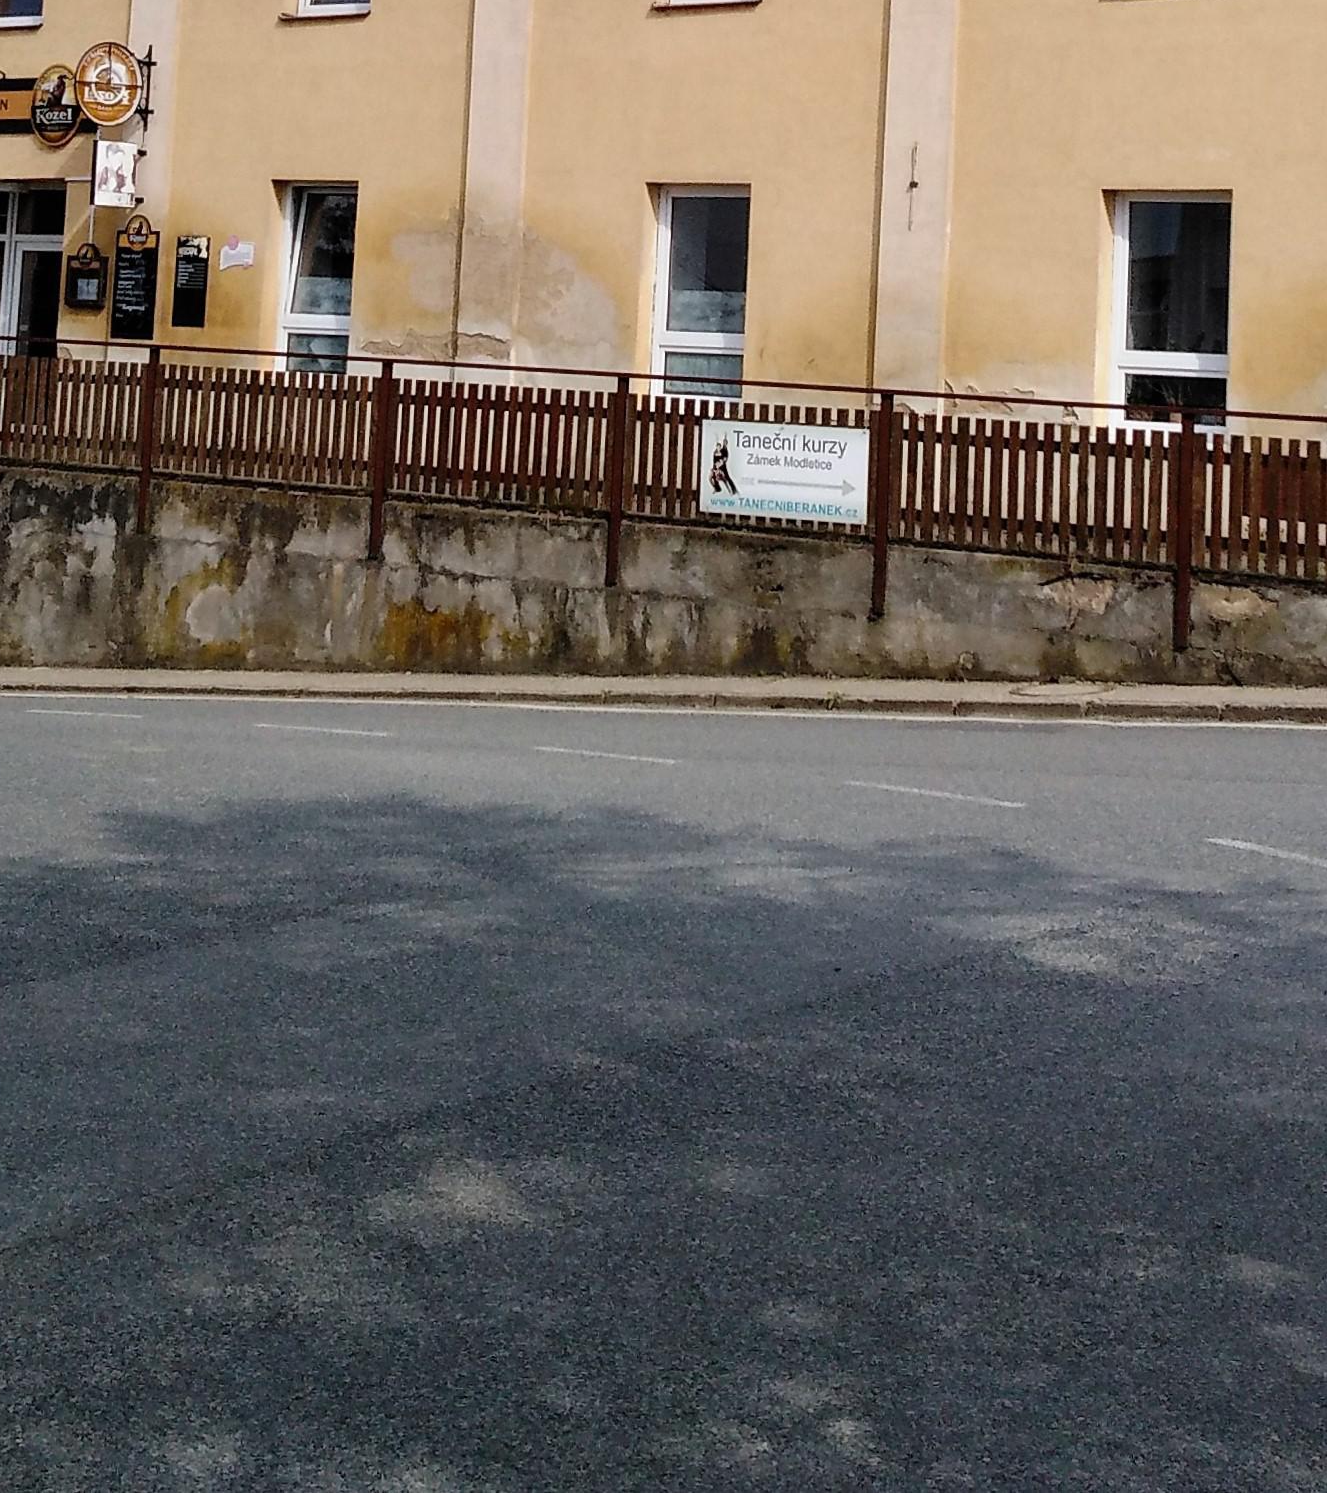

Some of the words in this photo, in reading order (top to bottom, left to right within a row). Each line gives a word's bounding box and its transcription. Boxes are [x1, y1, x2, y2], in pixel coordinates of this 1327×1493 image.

[36, 108, 72, 124] Kozel
[733, 430, 797, 452] Taneční
[802, 435, 847, 459] kurzy
[746, 453, 781, 467] Zámek
[784, 456, 832, 471] Modletice
